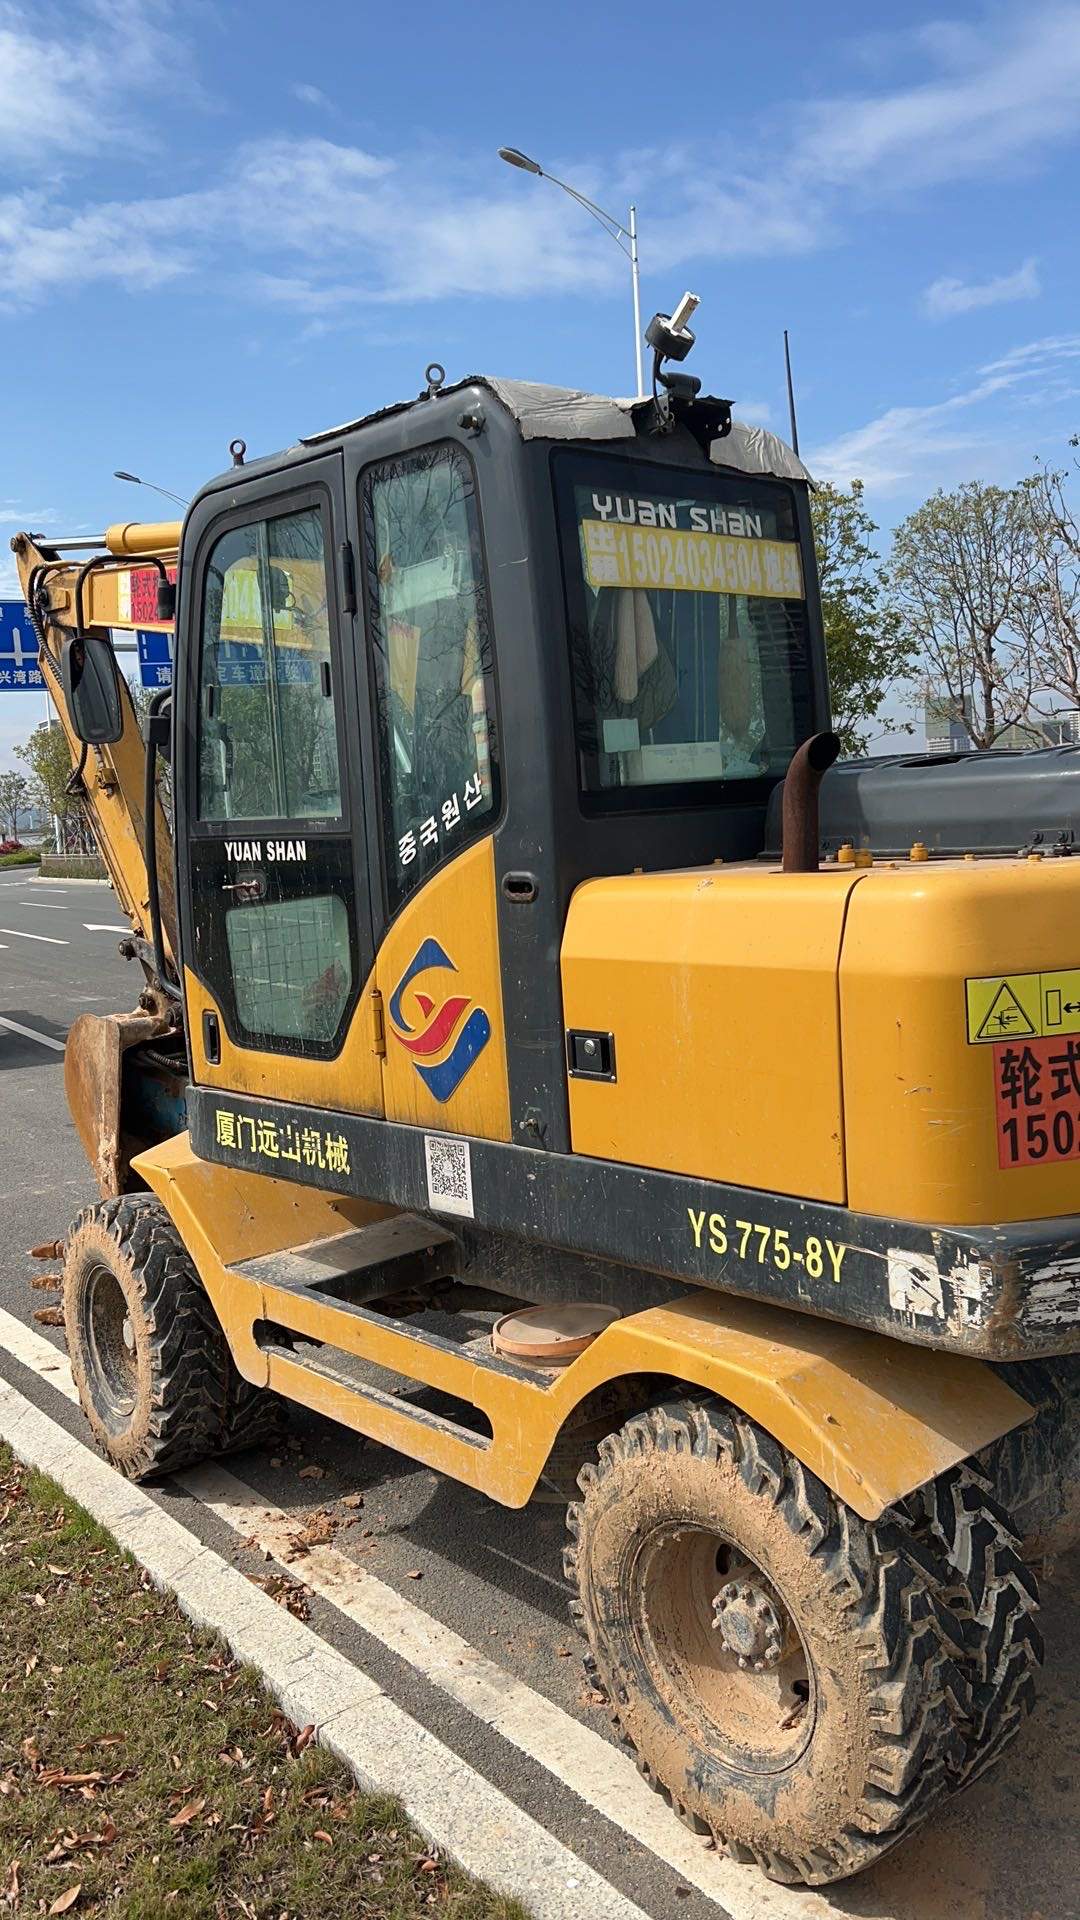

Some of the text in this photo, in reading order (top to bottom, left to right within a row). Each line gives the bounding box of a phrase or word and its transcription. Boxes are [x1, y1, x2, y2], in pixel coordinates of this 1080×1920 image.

[398, 772, 483, 865] 중국원산
[224, 840, 307, 862] YUAN SHAN
[216, 1109, 351, 1176] 厦门远山机械
[1002, 1110, 1080, 1162] 150
